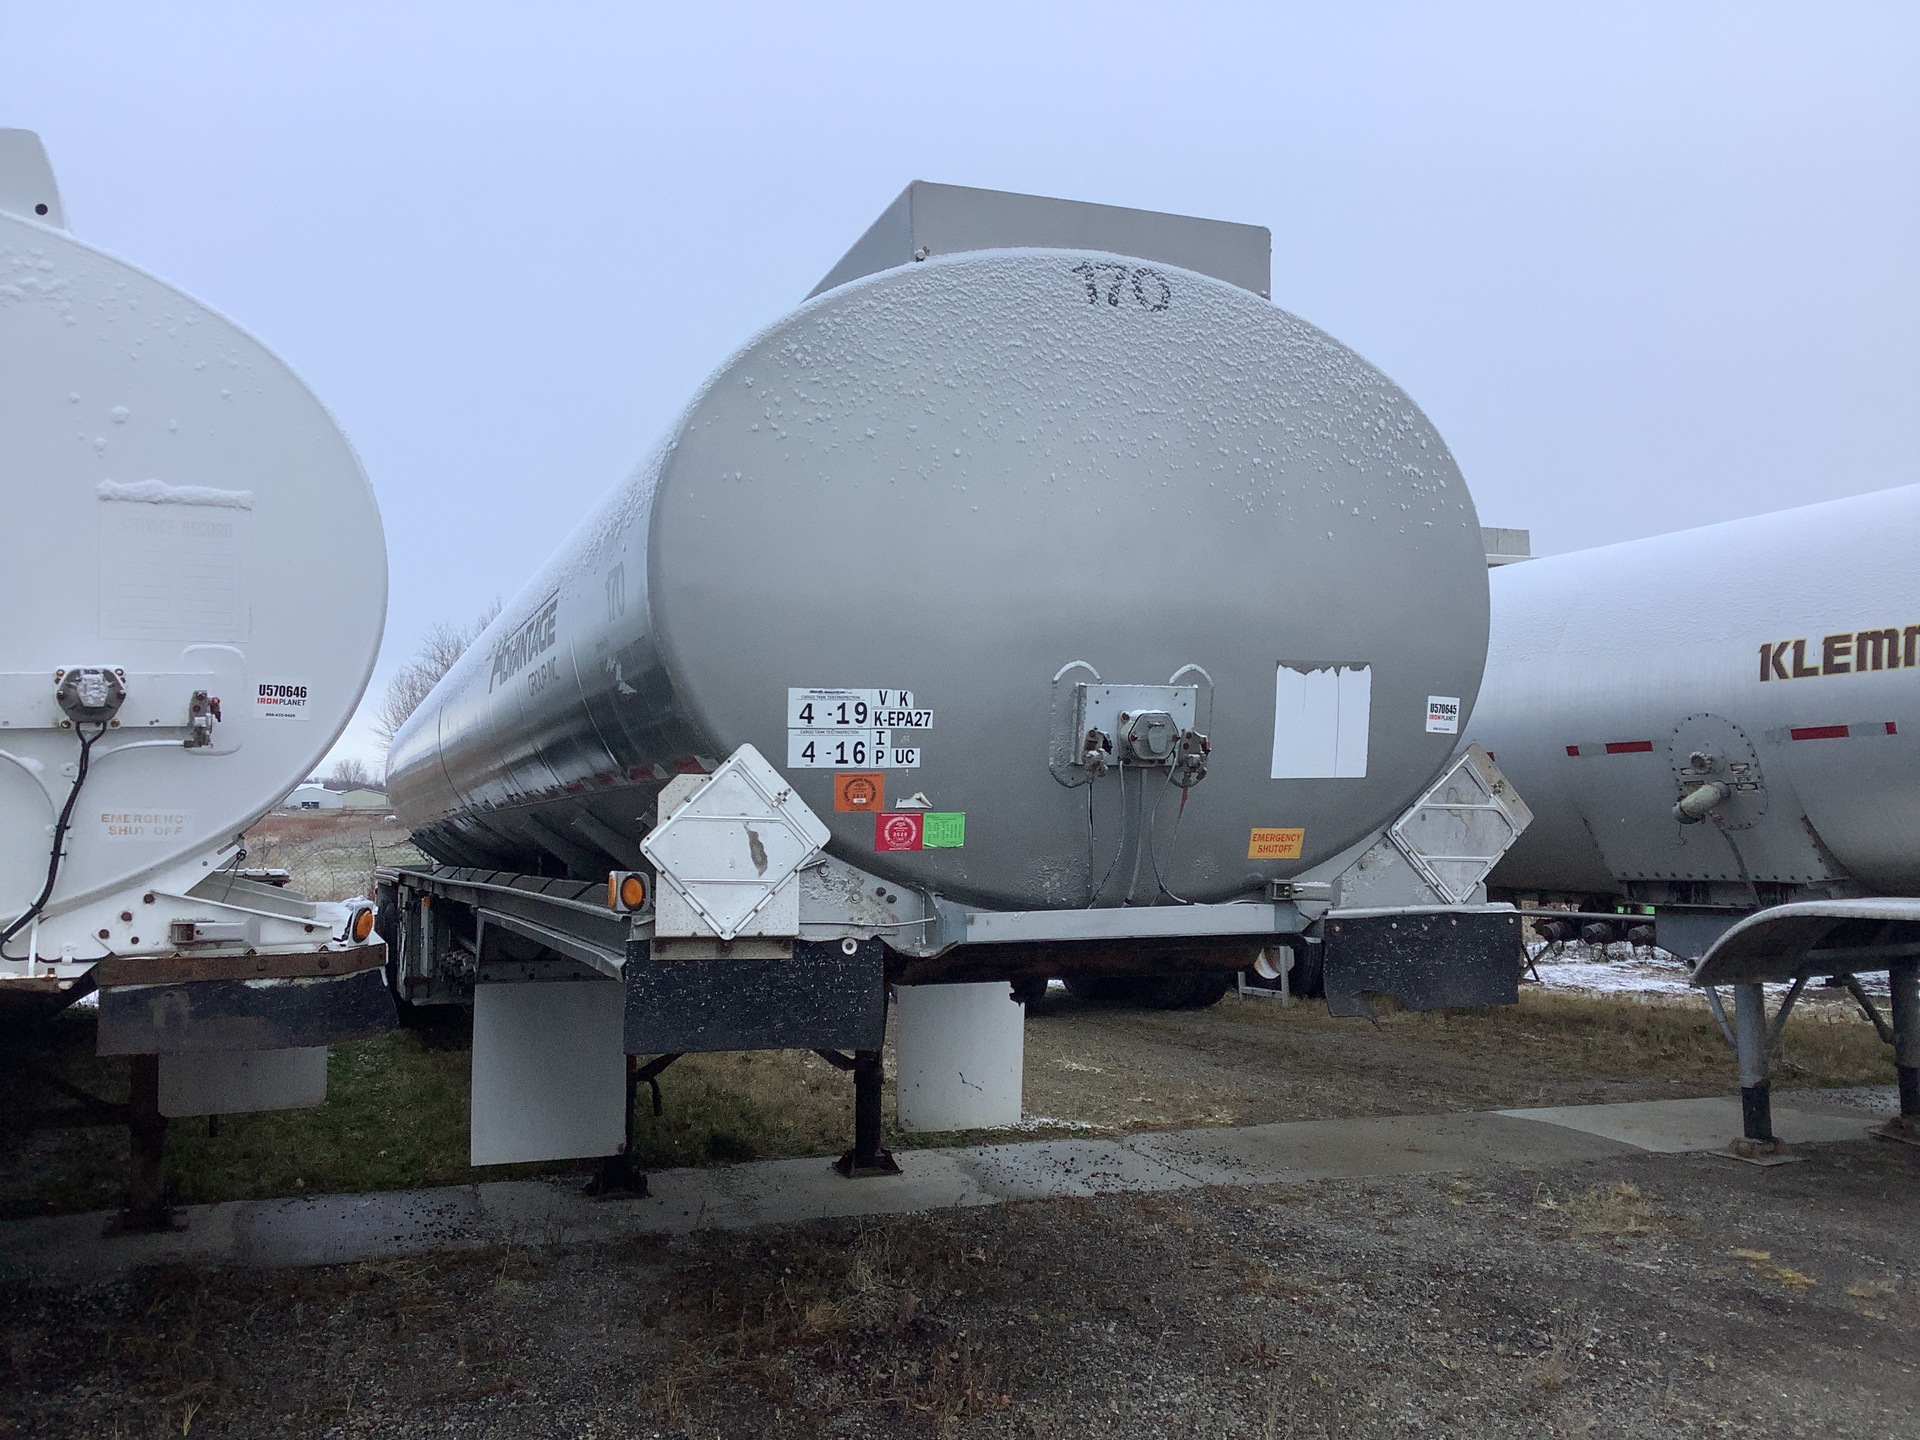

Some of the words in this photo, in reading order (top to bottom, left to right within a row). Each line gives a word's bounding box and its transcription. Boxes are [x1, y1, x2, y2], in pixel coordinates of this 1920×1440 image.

[1072, 261, 1171, 312] 170
[259, 684, 307, 698] U570646
[879, 690, 888, 706] V
[899, 691, 908, 706] K
[257, 697, 306, 706] IRONPLANET
[1430, 703, 1457, 714] U570645
[799, 703, 814, 724] 4
[874, 711, 931, 727] K-EPA27
[801, 741, 815, 763] 4
[875, 750, 884, 764] P
[895, 749, 915, 764] UC
[1253, 833, 1302, 842] EMERGENCY
[1257, 844, 1294, 853] SHUTOFF
